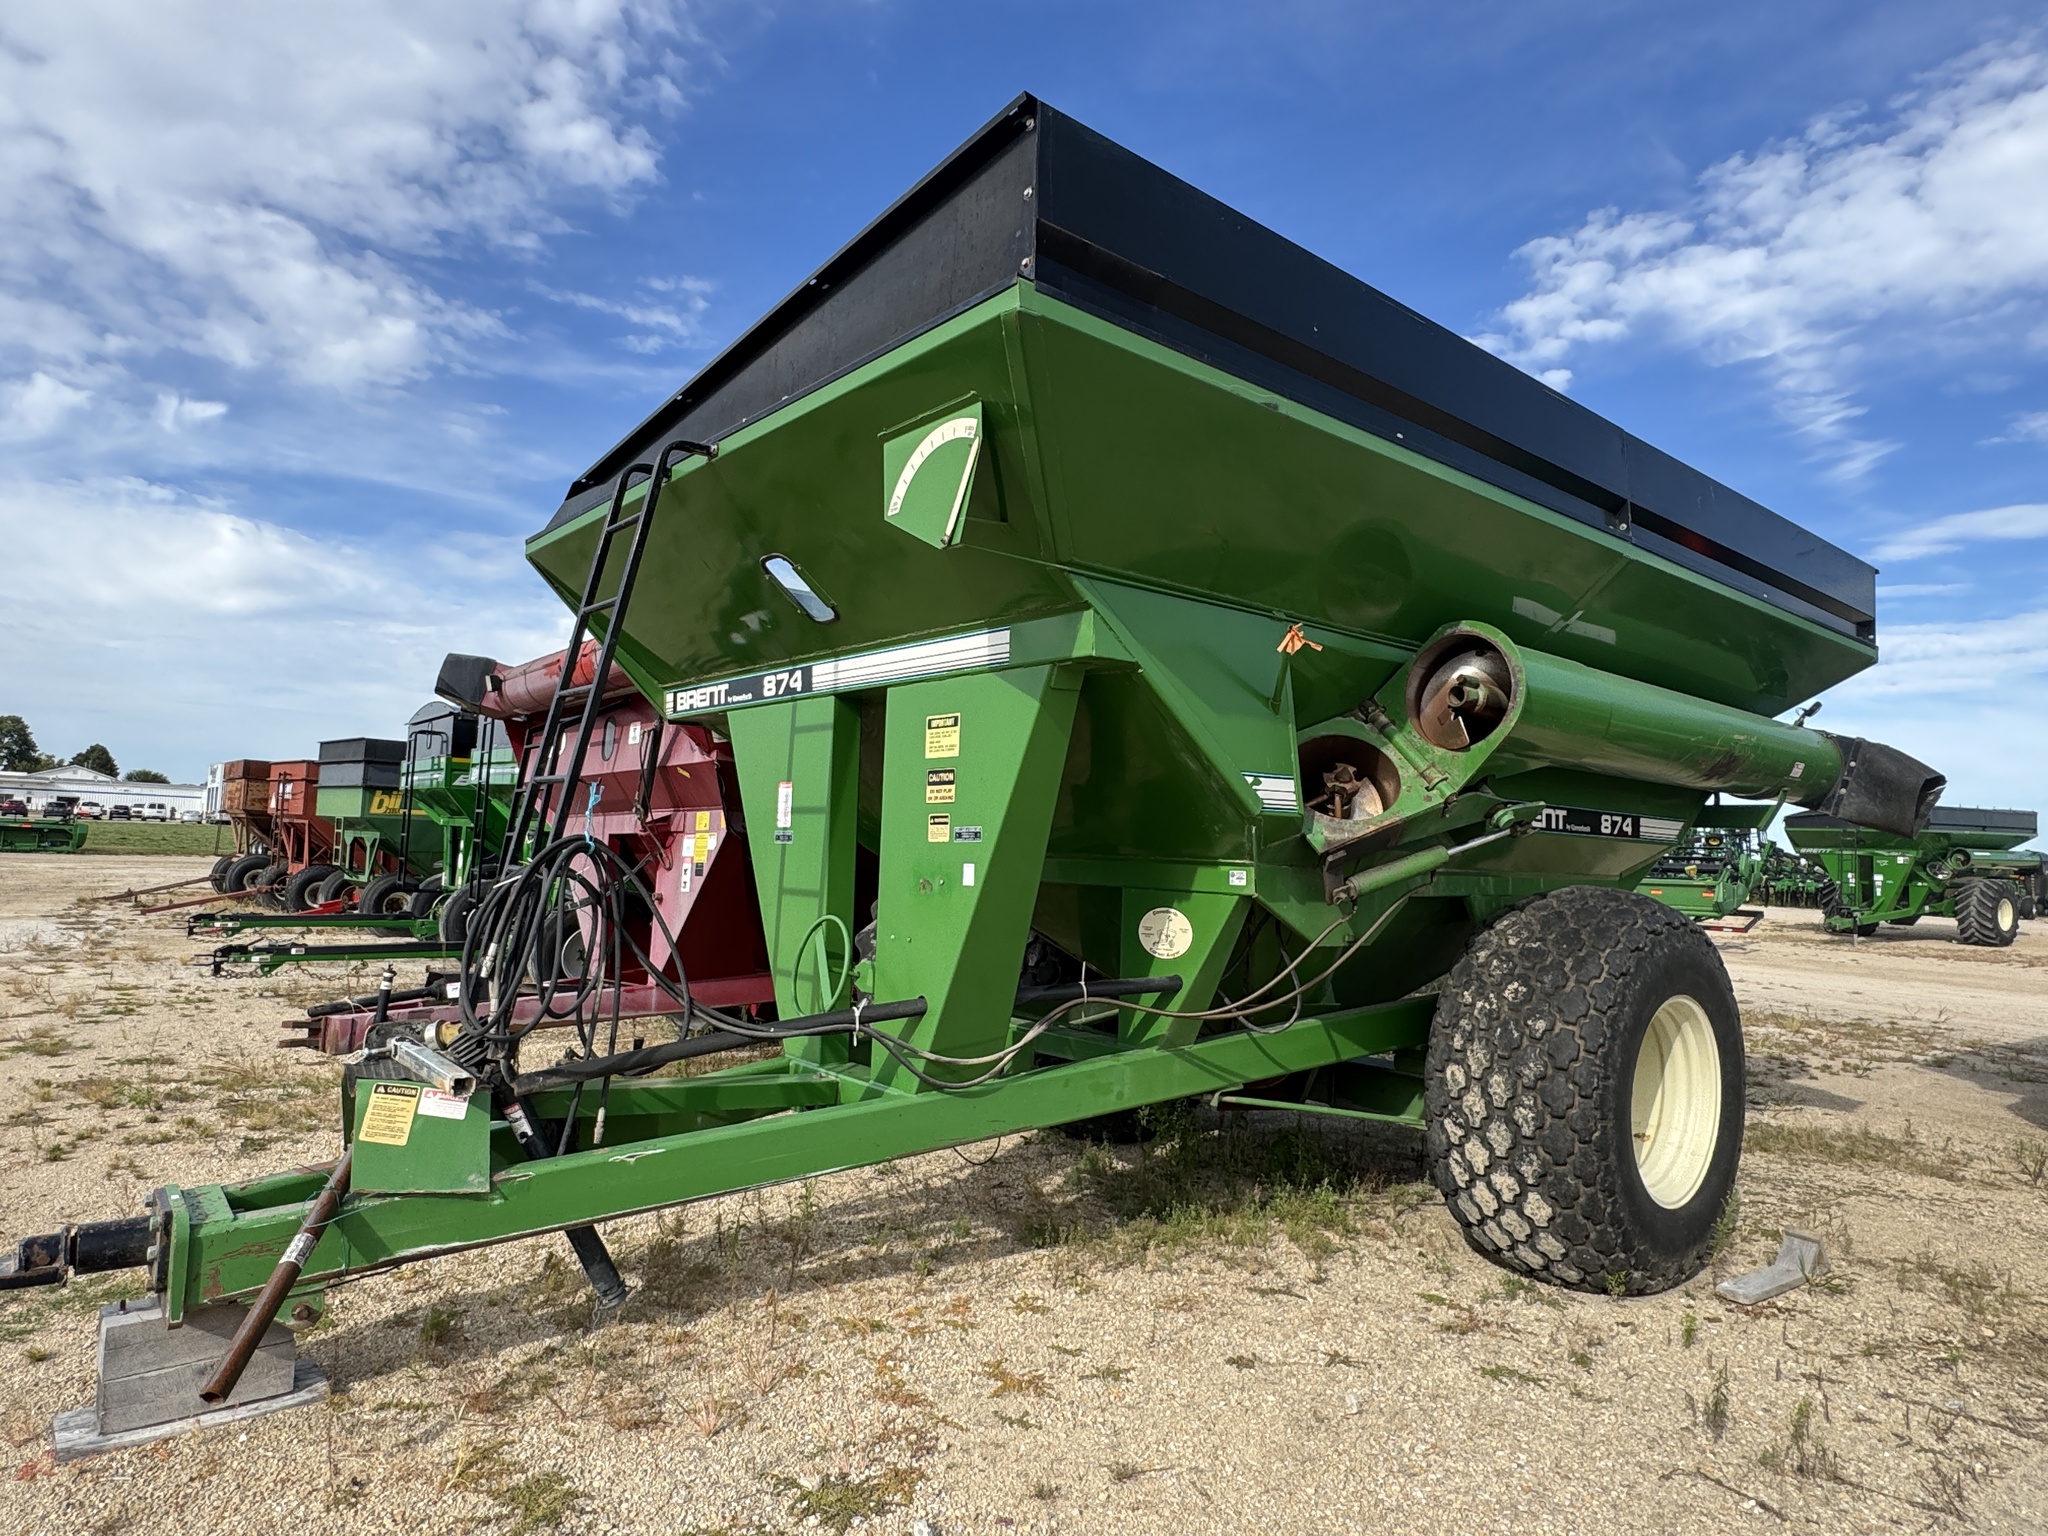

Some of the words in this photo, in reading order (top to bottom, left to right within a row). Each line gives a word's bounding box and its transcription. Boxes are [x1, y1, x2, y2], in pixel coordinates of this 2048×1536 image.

[676, 683, 729, 711] BRENT
[763, 669, 802, 697] 874
[928, 772, 954, 783] CAUTION
[1600, 814, 1633, 836] 874
[386, 1086, 417, 1096] CAUTION
